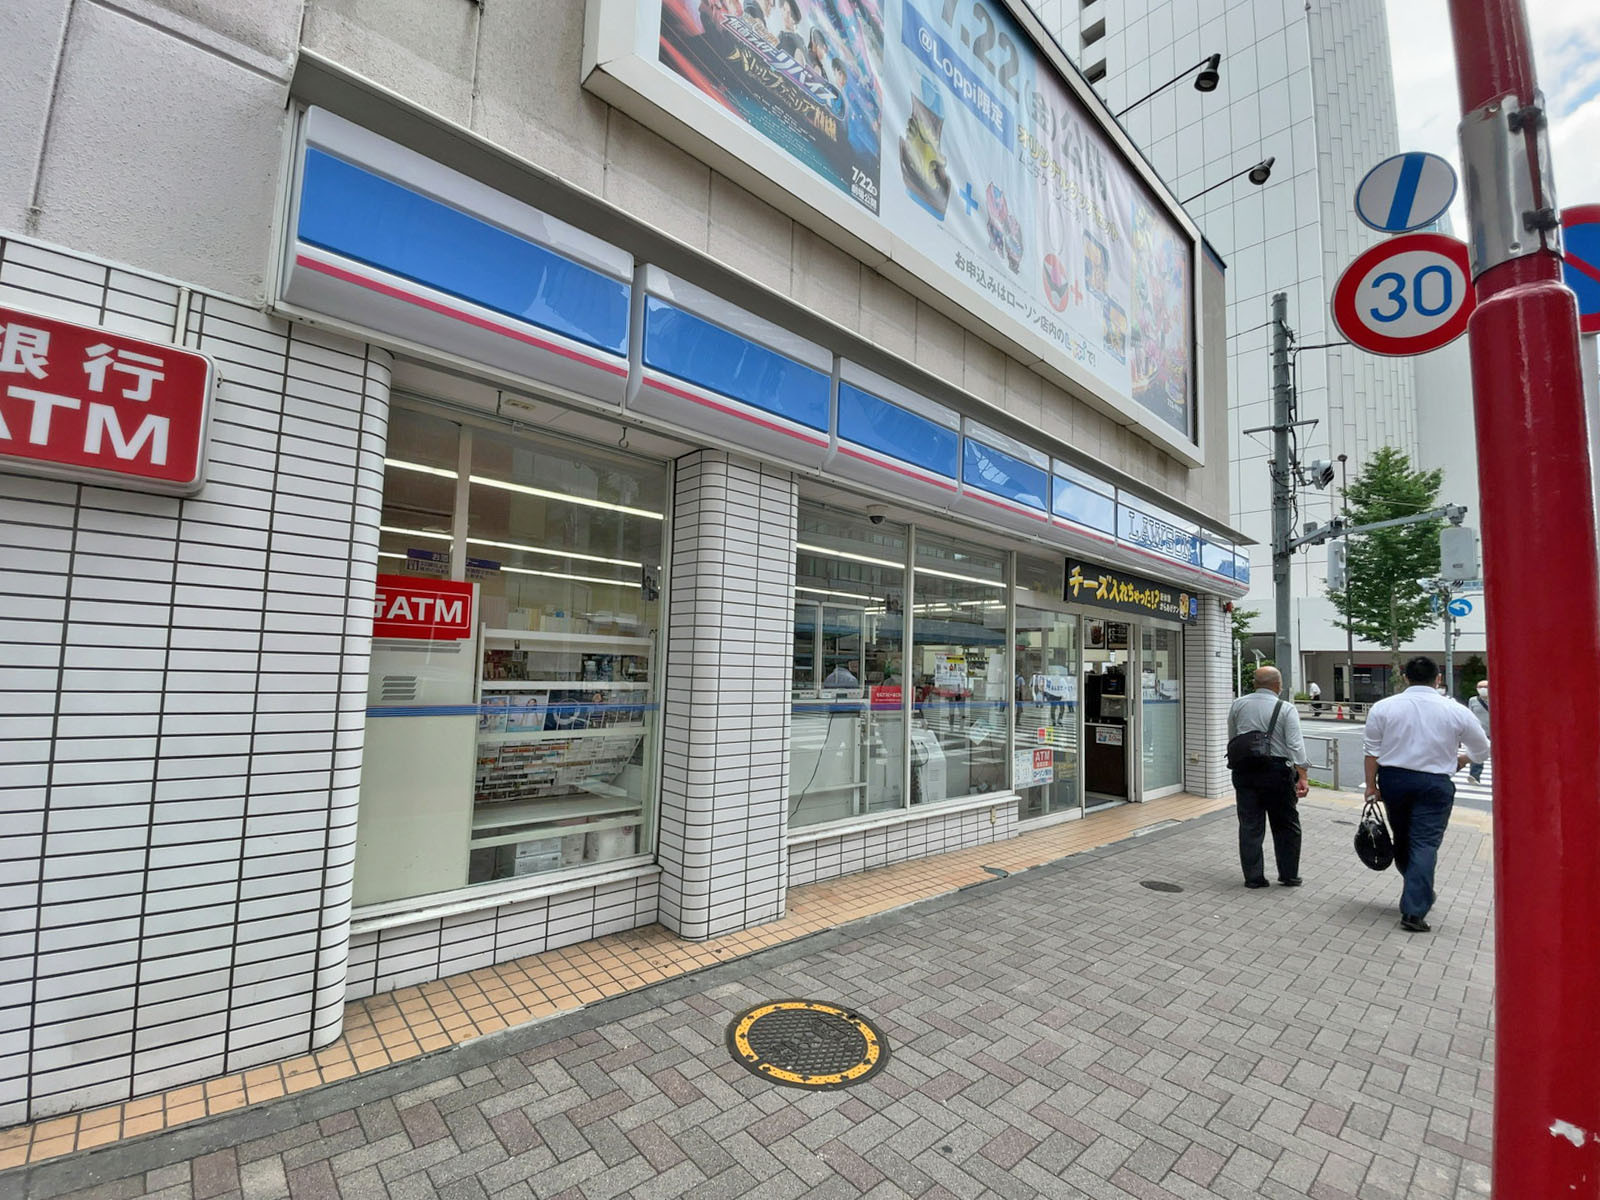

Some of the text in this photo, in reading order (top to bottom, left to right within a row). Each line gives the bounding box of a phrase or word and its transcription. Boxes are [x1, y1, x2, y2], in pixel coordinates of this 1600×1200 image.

[919, 27, 1004, 133] @Loppi限定
[1370, 265, 1452, 323] 30
[0, 385, 170, 466] TM
[1128, 510, 1193, 562] LAWSON
[1036, 750, 1050, 762] ATM
